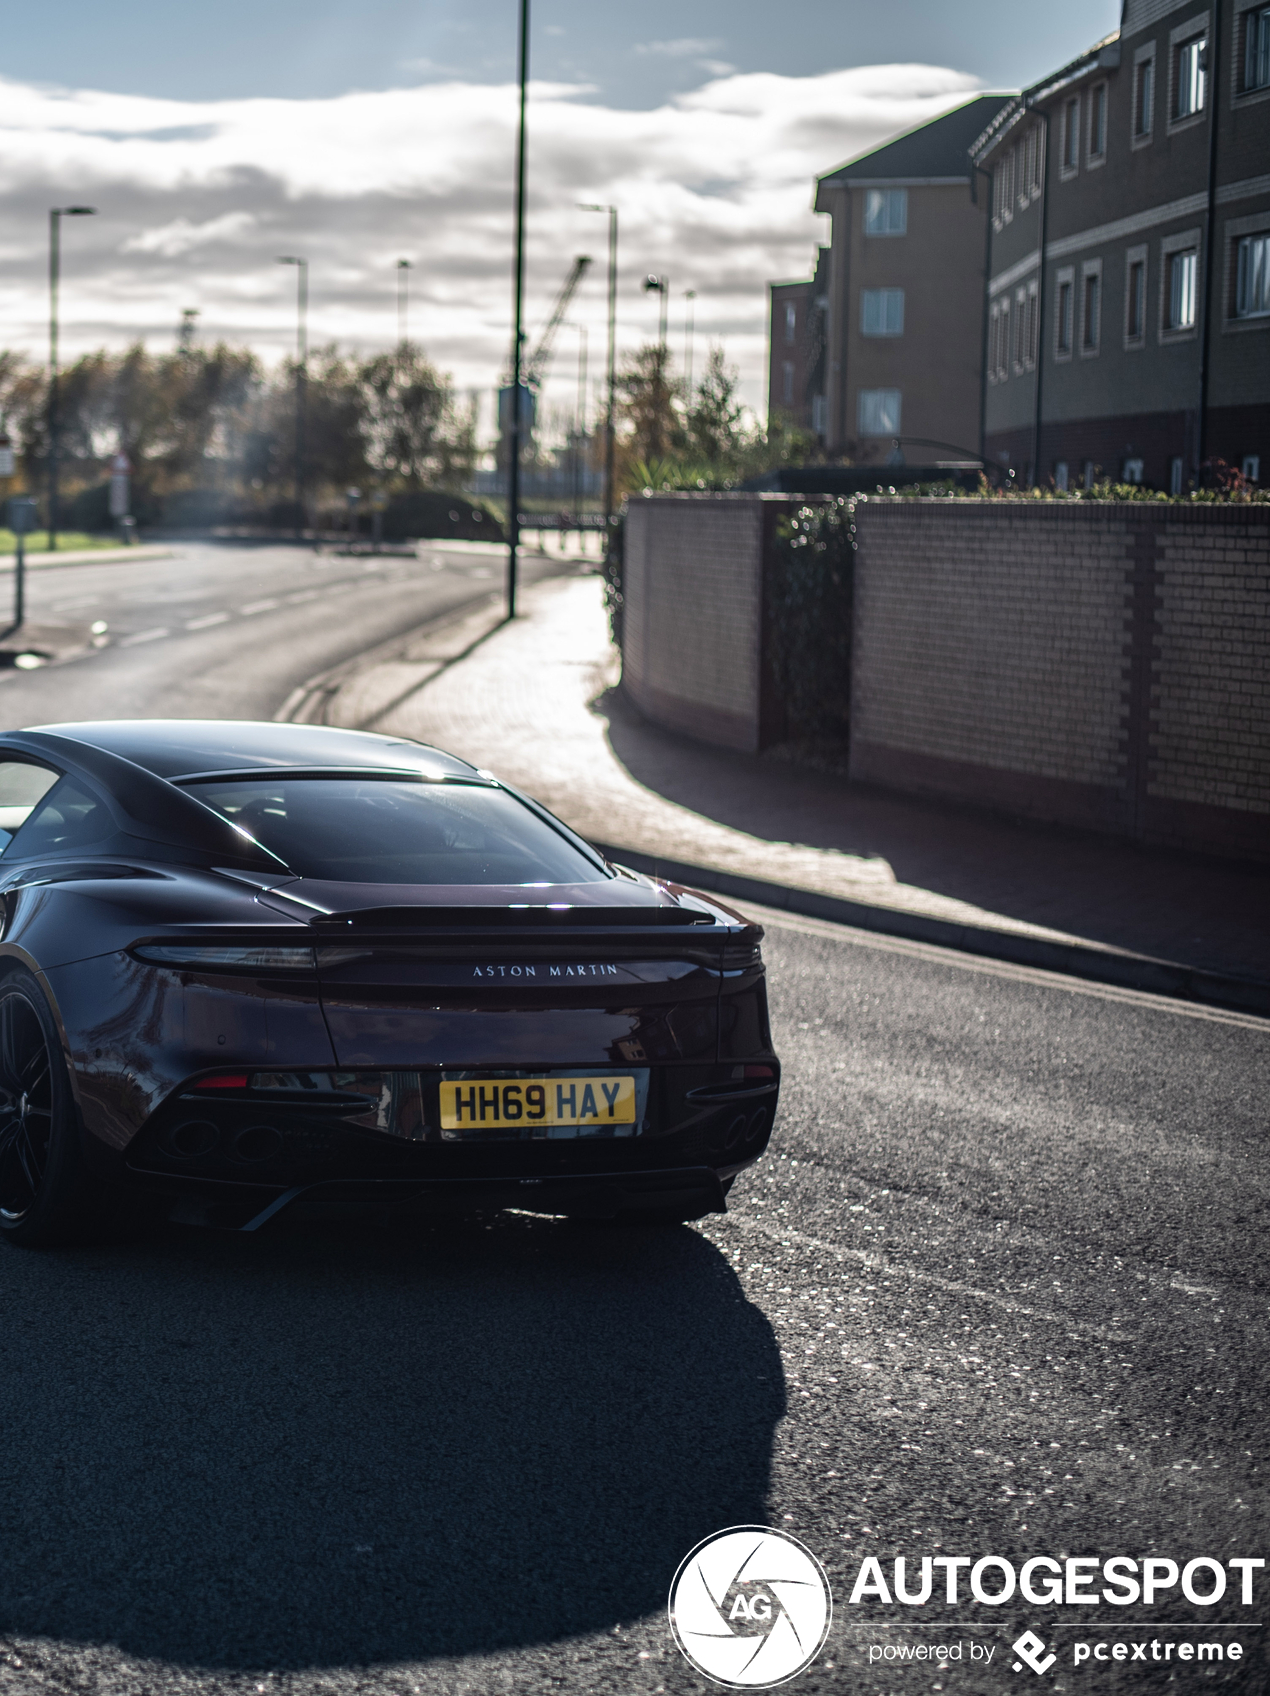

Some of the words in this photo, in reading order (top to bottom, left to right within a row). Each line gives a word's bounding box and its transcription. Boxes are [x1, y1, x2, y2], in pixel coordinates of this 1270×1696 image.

[473, 965, 536, 977] ASTON
[549, 963, 617, 976] MARTIN
[455, 1085, 545, 1121] HH69
[556, 1082, 620, 1118] HAY
